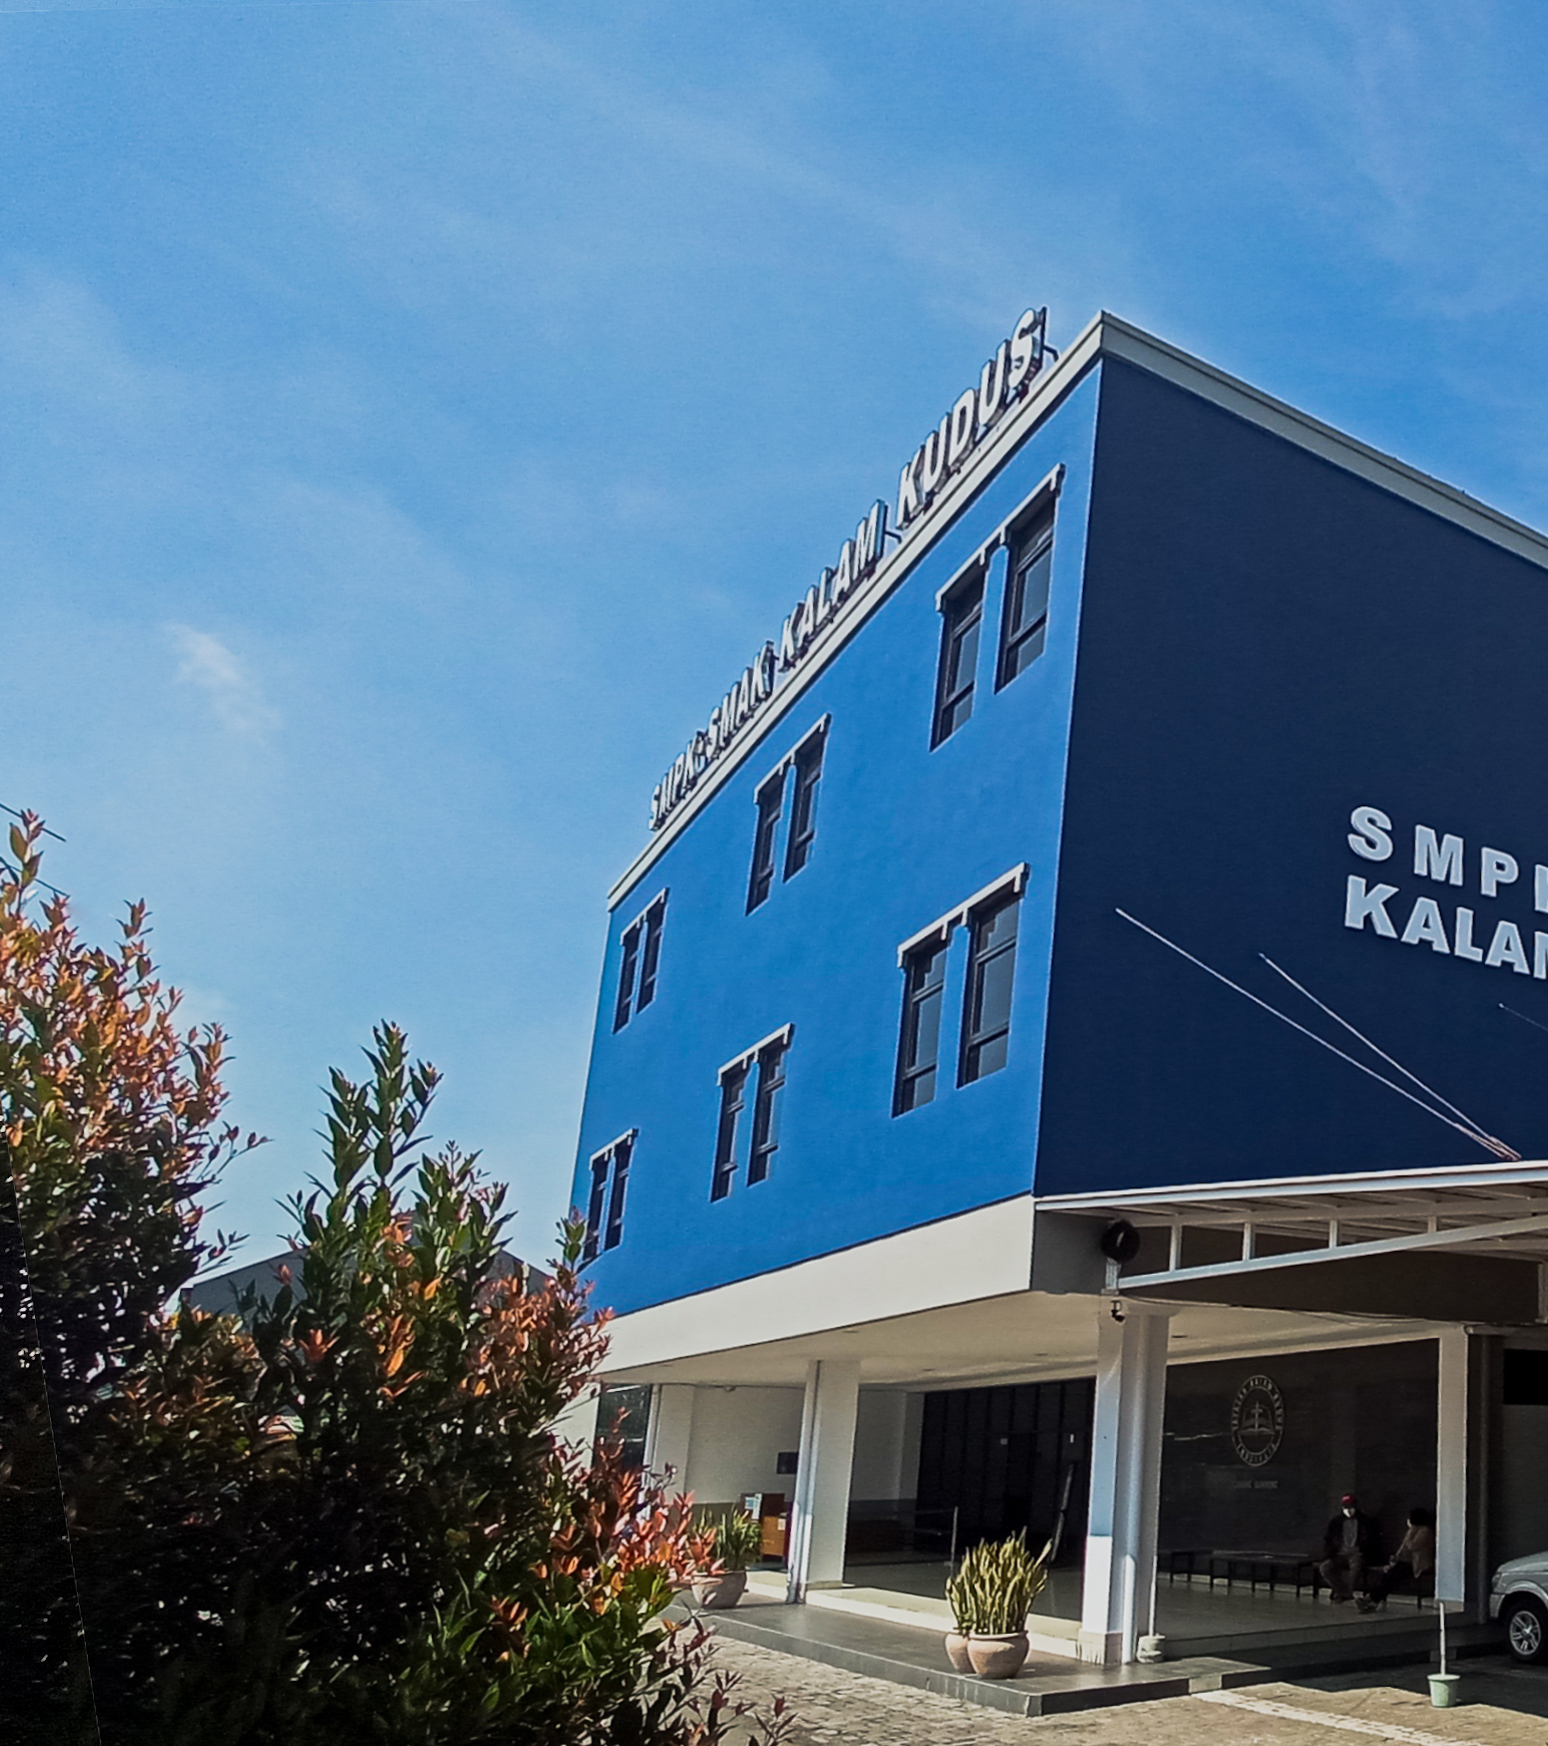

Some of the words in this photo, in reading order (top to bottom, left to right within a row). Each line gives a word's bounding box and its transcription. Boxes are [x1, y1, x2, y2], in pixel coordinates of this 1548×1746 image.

[649, 730, 704, 830] SMPK
[706, 640, 772, 758] SMAK
[780, 499, 887, 670] KALAM
[896, 307, 1042, 529] KUDUS
